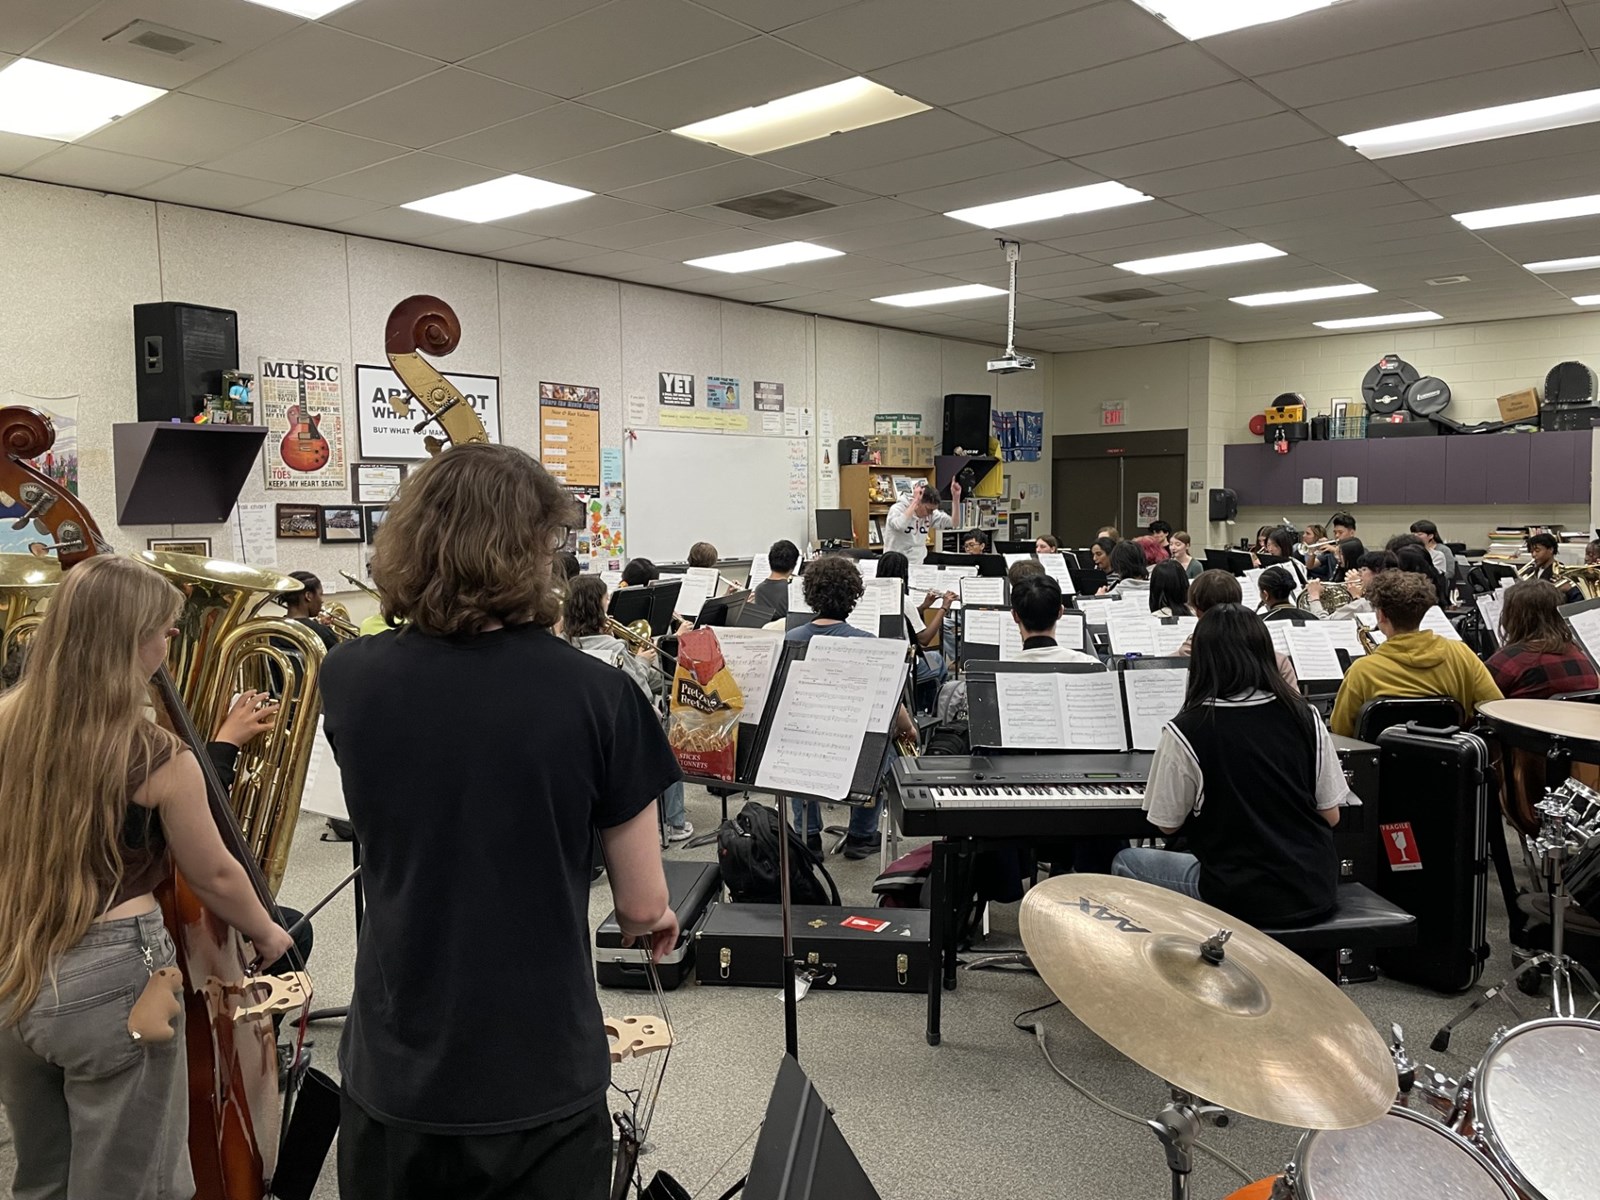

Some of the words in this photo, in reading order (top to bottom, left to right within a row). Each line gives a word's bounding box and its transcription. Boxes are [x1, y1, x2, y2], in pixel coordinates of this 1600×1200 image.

[262, 362, 339, 382] MUSIC
[662, 374, 692, 394] YET
[1104, 411, 1121, 424] EXIT
[272, 470, 291, 480] TOES
[681, 683, 717, 707] Pretzels
[679, 753, 701, 761] STICKS
[1381, 822, 1409, 831] FRAGILE
